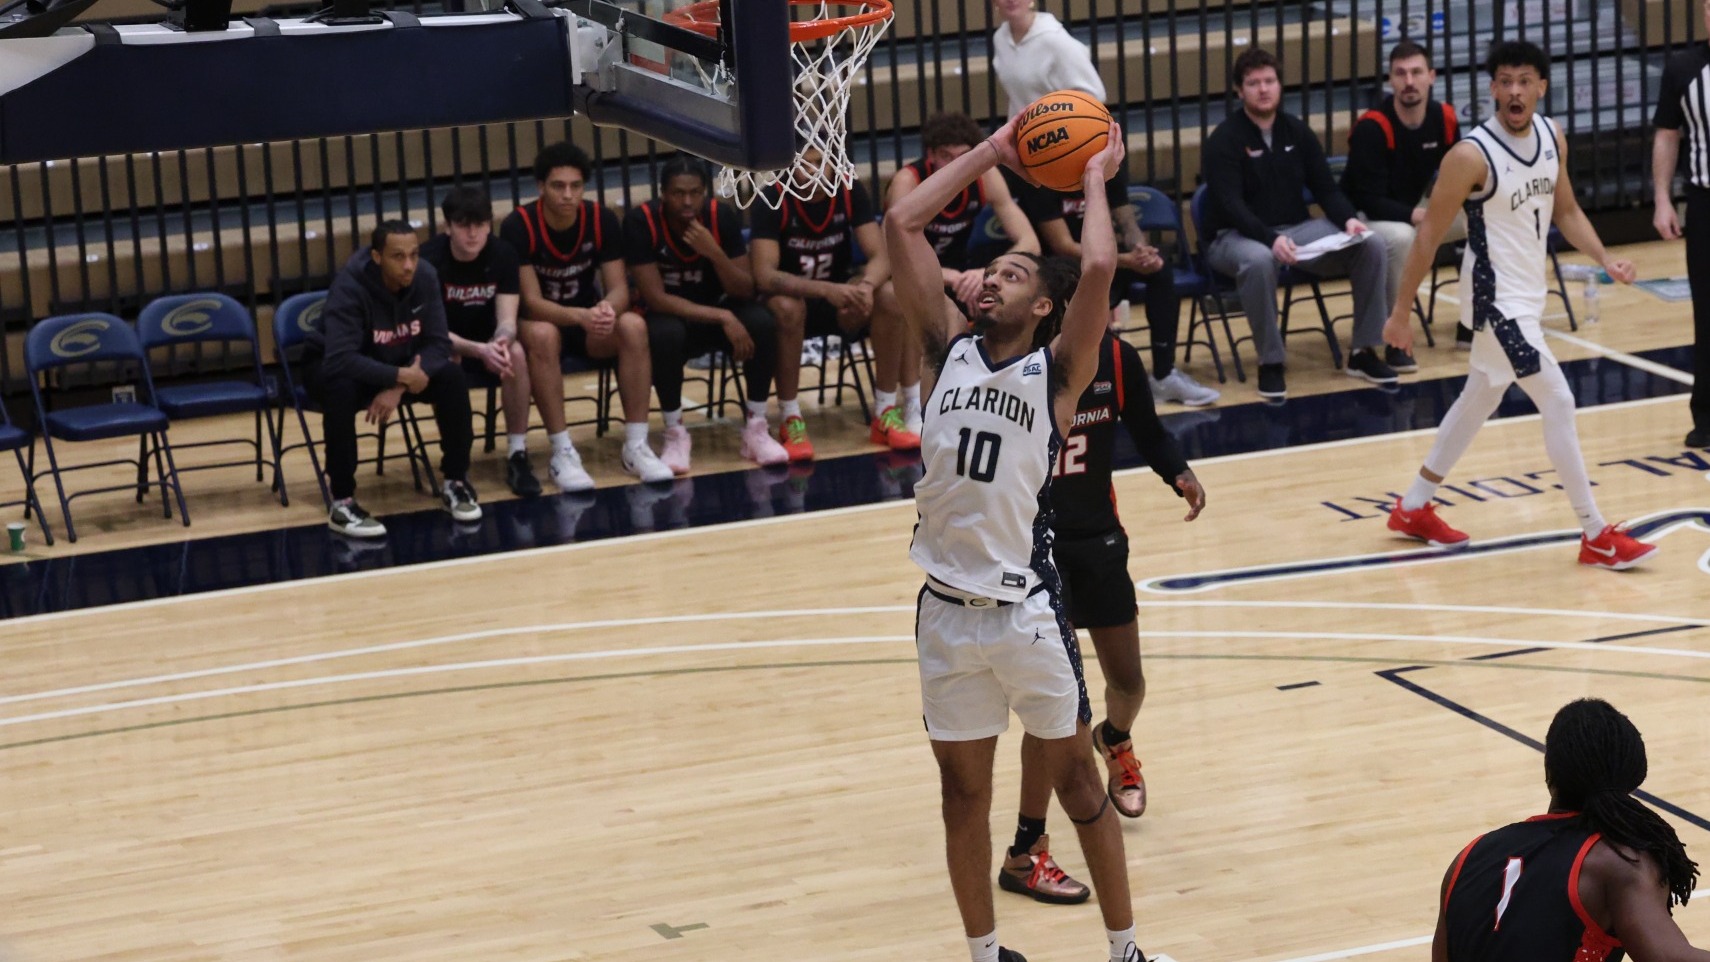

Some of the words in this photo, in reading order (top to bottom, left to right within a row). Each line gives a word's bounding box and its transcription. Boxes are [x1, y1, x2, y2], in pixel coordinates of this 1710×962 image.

[1019, 102, 1074, 131] Wilson
[1026, 126, 1070, 155] NCAA
[1533, 207, 1541, 240] 1
[939, 386, 1036, 434] CLARION
[956, 427, 1002, 483] 10
[1597, 448, 1710, 477] AL
[1493, 857, 1524, 931] 1
